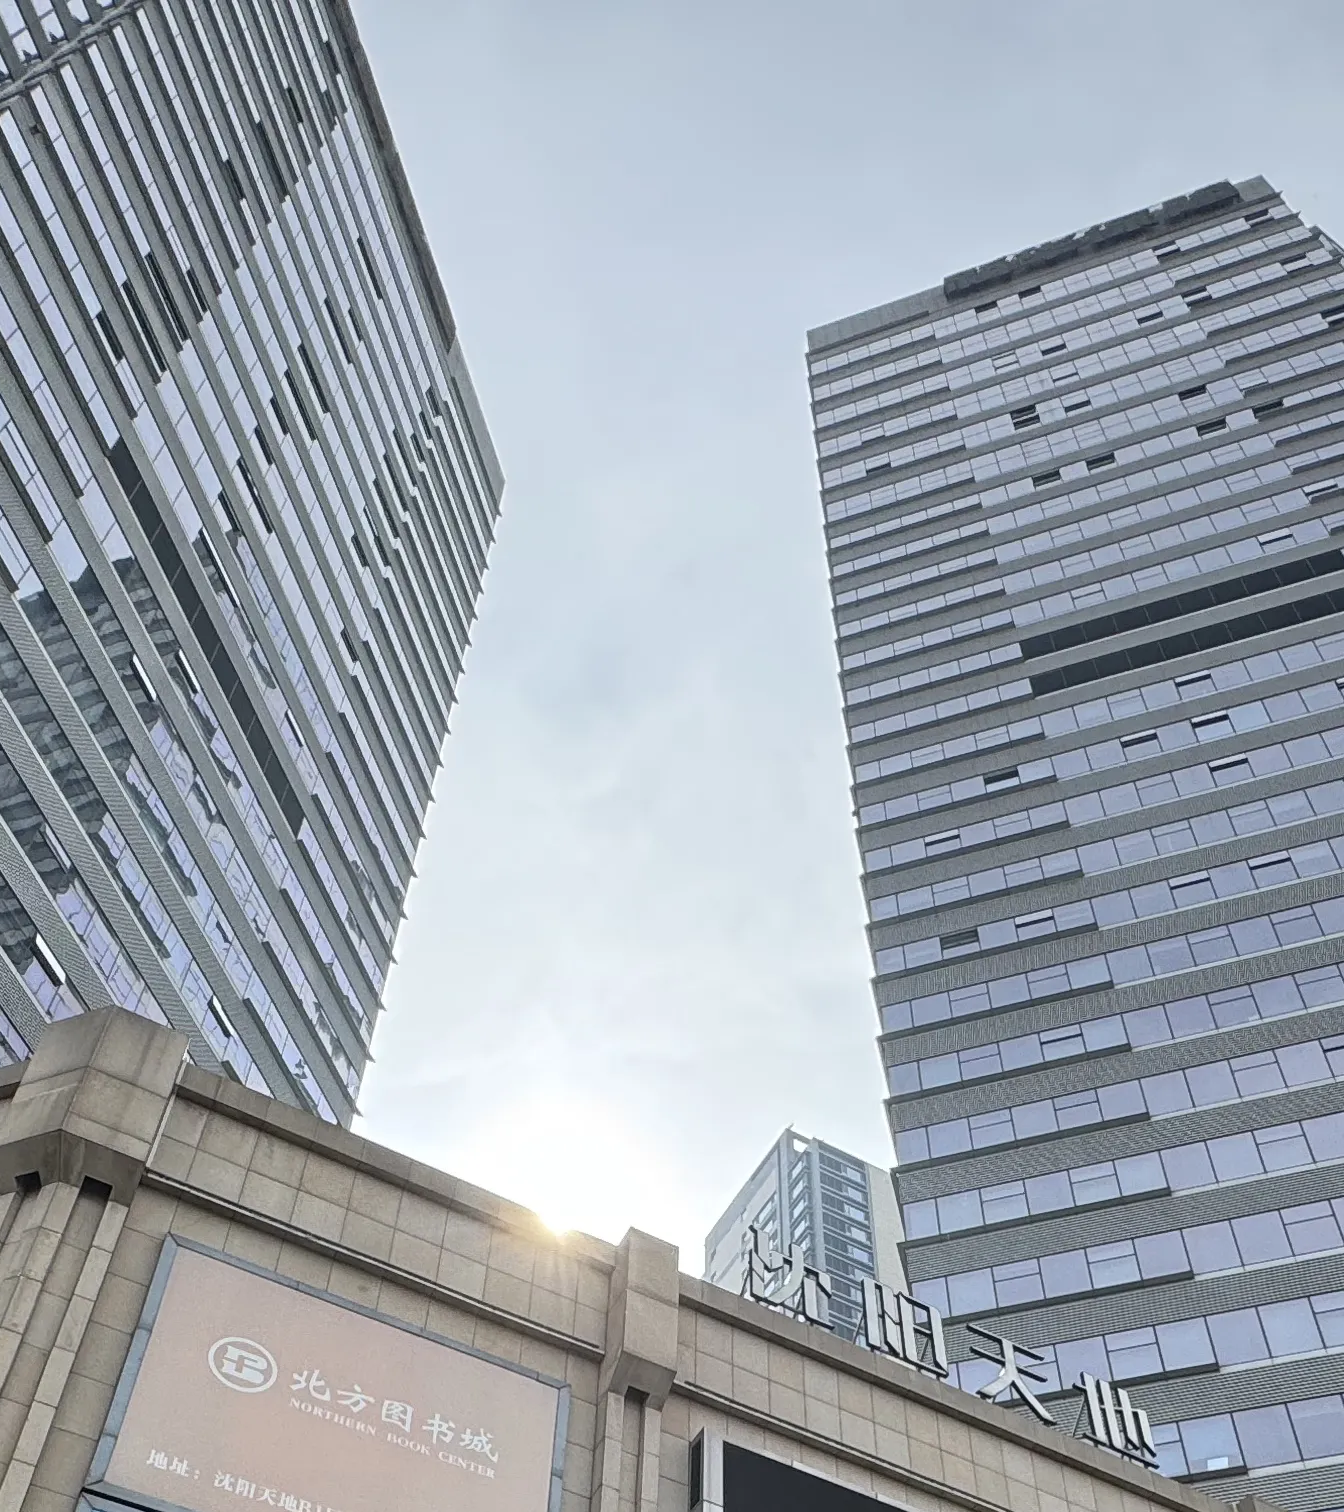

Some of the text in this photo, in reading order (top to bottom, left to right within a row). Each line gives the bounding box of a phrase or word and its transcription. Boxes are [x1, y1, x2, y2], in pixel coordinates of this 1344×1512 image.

[288, 1368, 499, 1464] 北方图书城
[288, 1397, 497, 1480] NORTHERN BOOK CENTER
